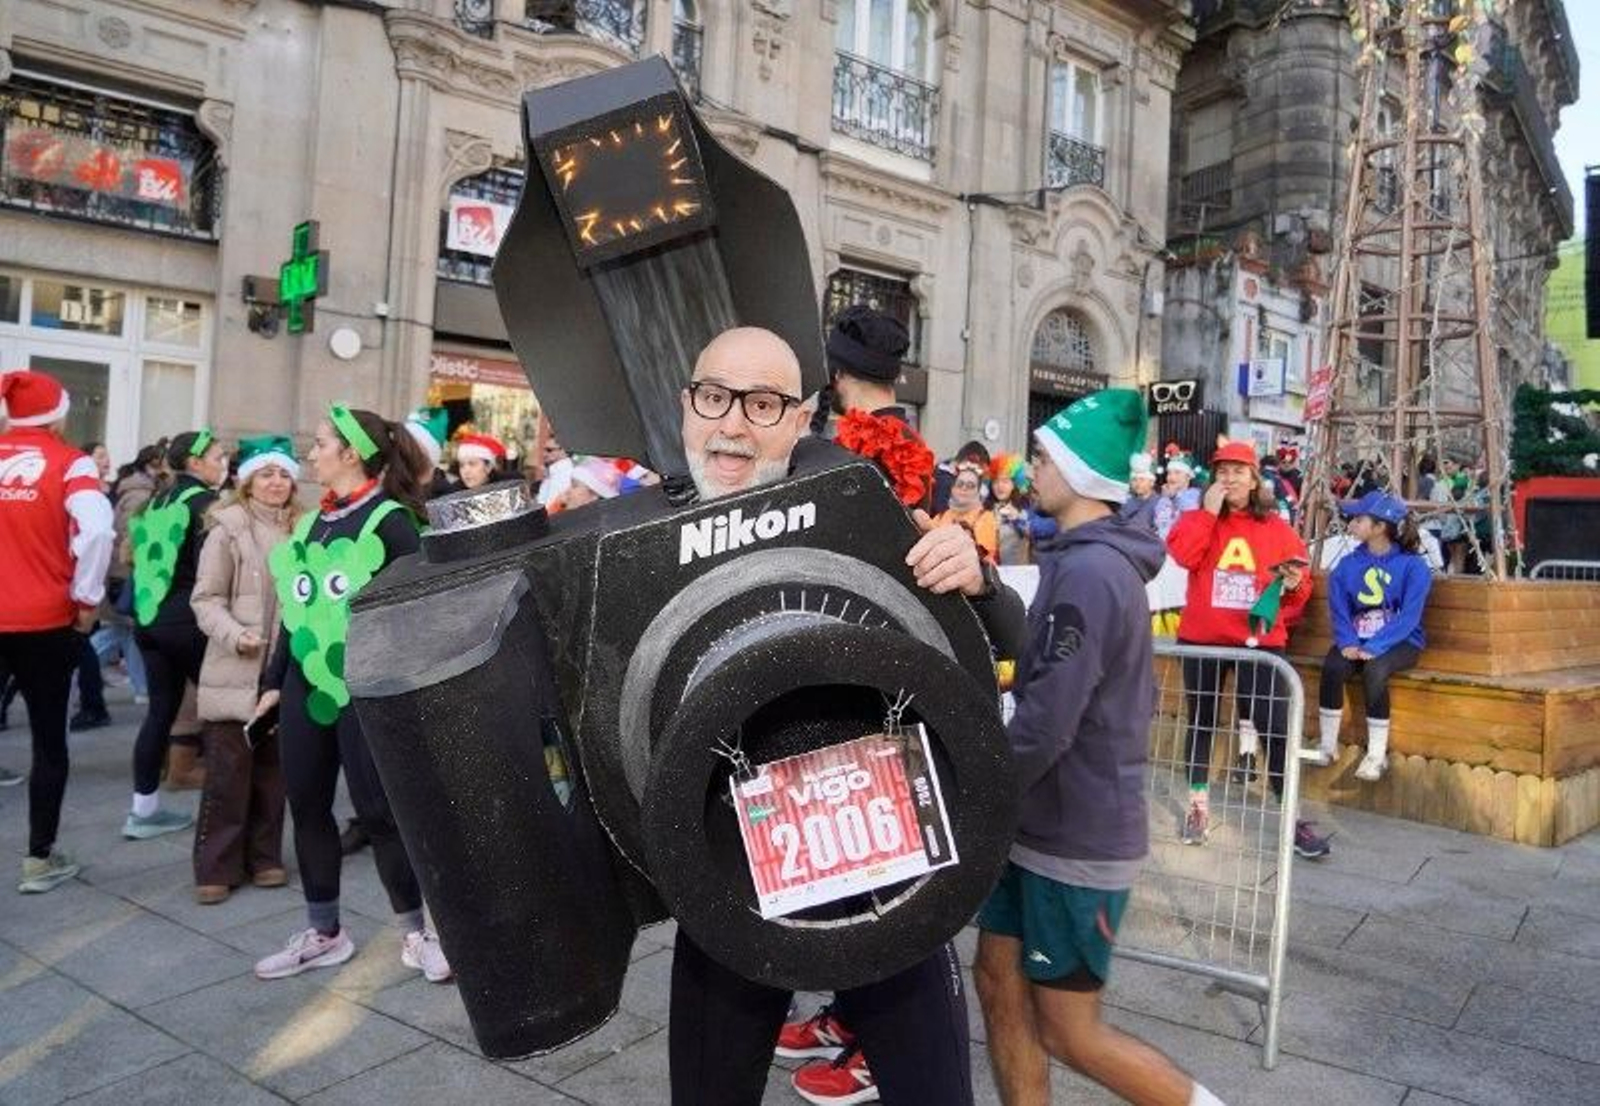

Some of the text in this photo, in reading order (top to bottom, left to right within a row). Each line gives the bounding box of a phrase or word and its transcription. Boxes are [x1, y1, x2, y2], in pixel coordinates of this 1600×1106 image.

[679, 502, 816, 565] Nikon
[1216, 537, 1256, 572] A
[1357, 566, 1392, 606] S
[788, 770, 871, 805] vigo
[771, 797, 902, 880] 2006
